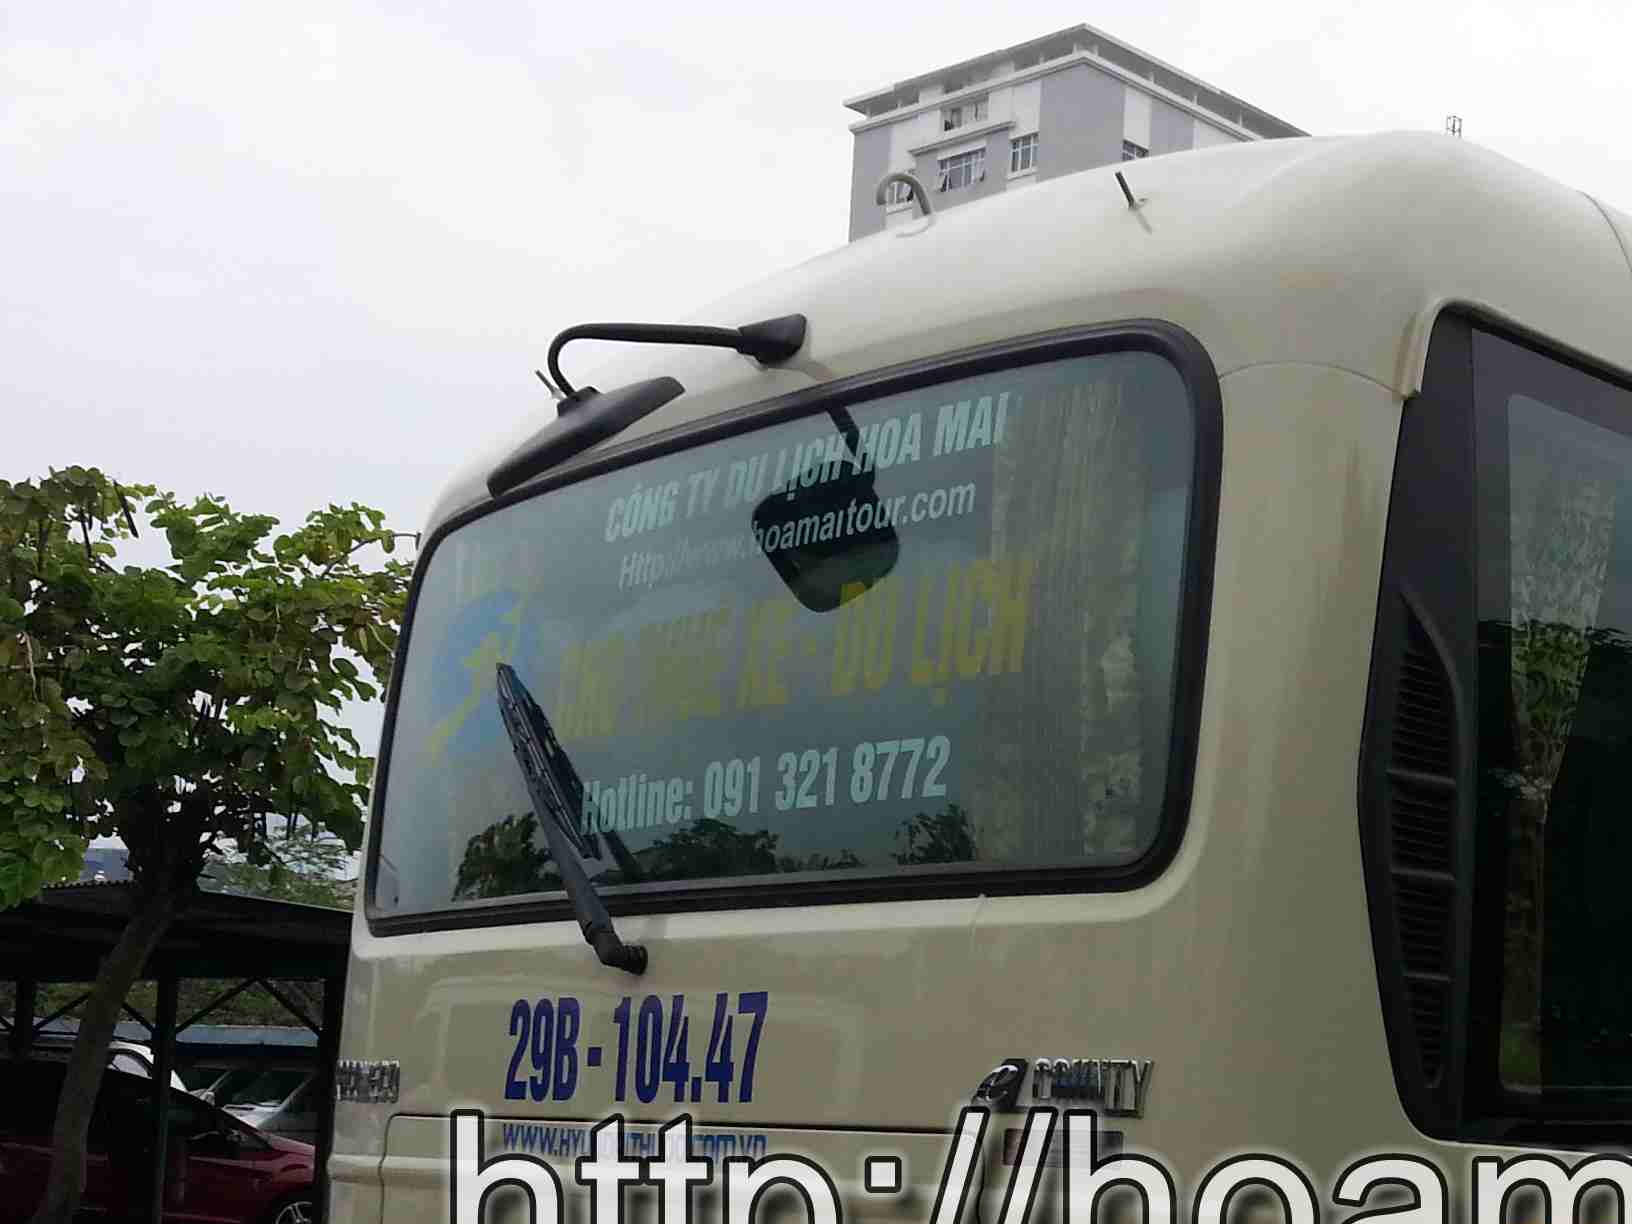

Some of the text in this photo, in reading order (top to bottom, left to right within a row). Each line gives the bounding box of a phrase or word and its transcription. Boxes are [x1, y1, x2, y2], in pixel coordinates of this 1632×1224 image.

[685, 470, 721, 518] TY
[727, 449, 768, 501] DU
[851, 413, 923, 474] HOA
[933, 394, 1010, 457] MAI
[581, 735, 952, 834] Hotline: 091 321 8772
